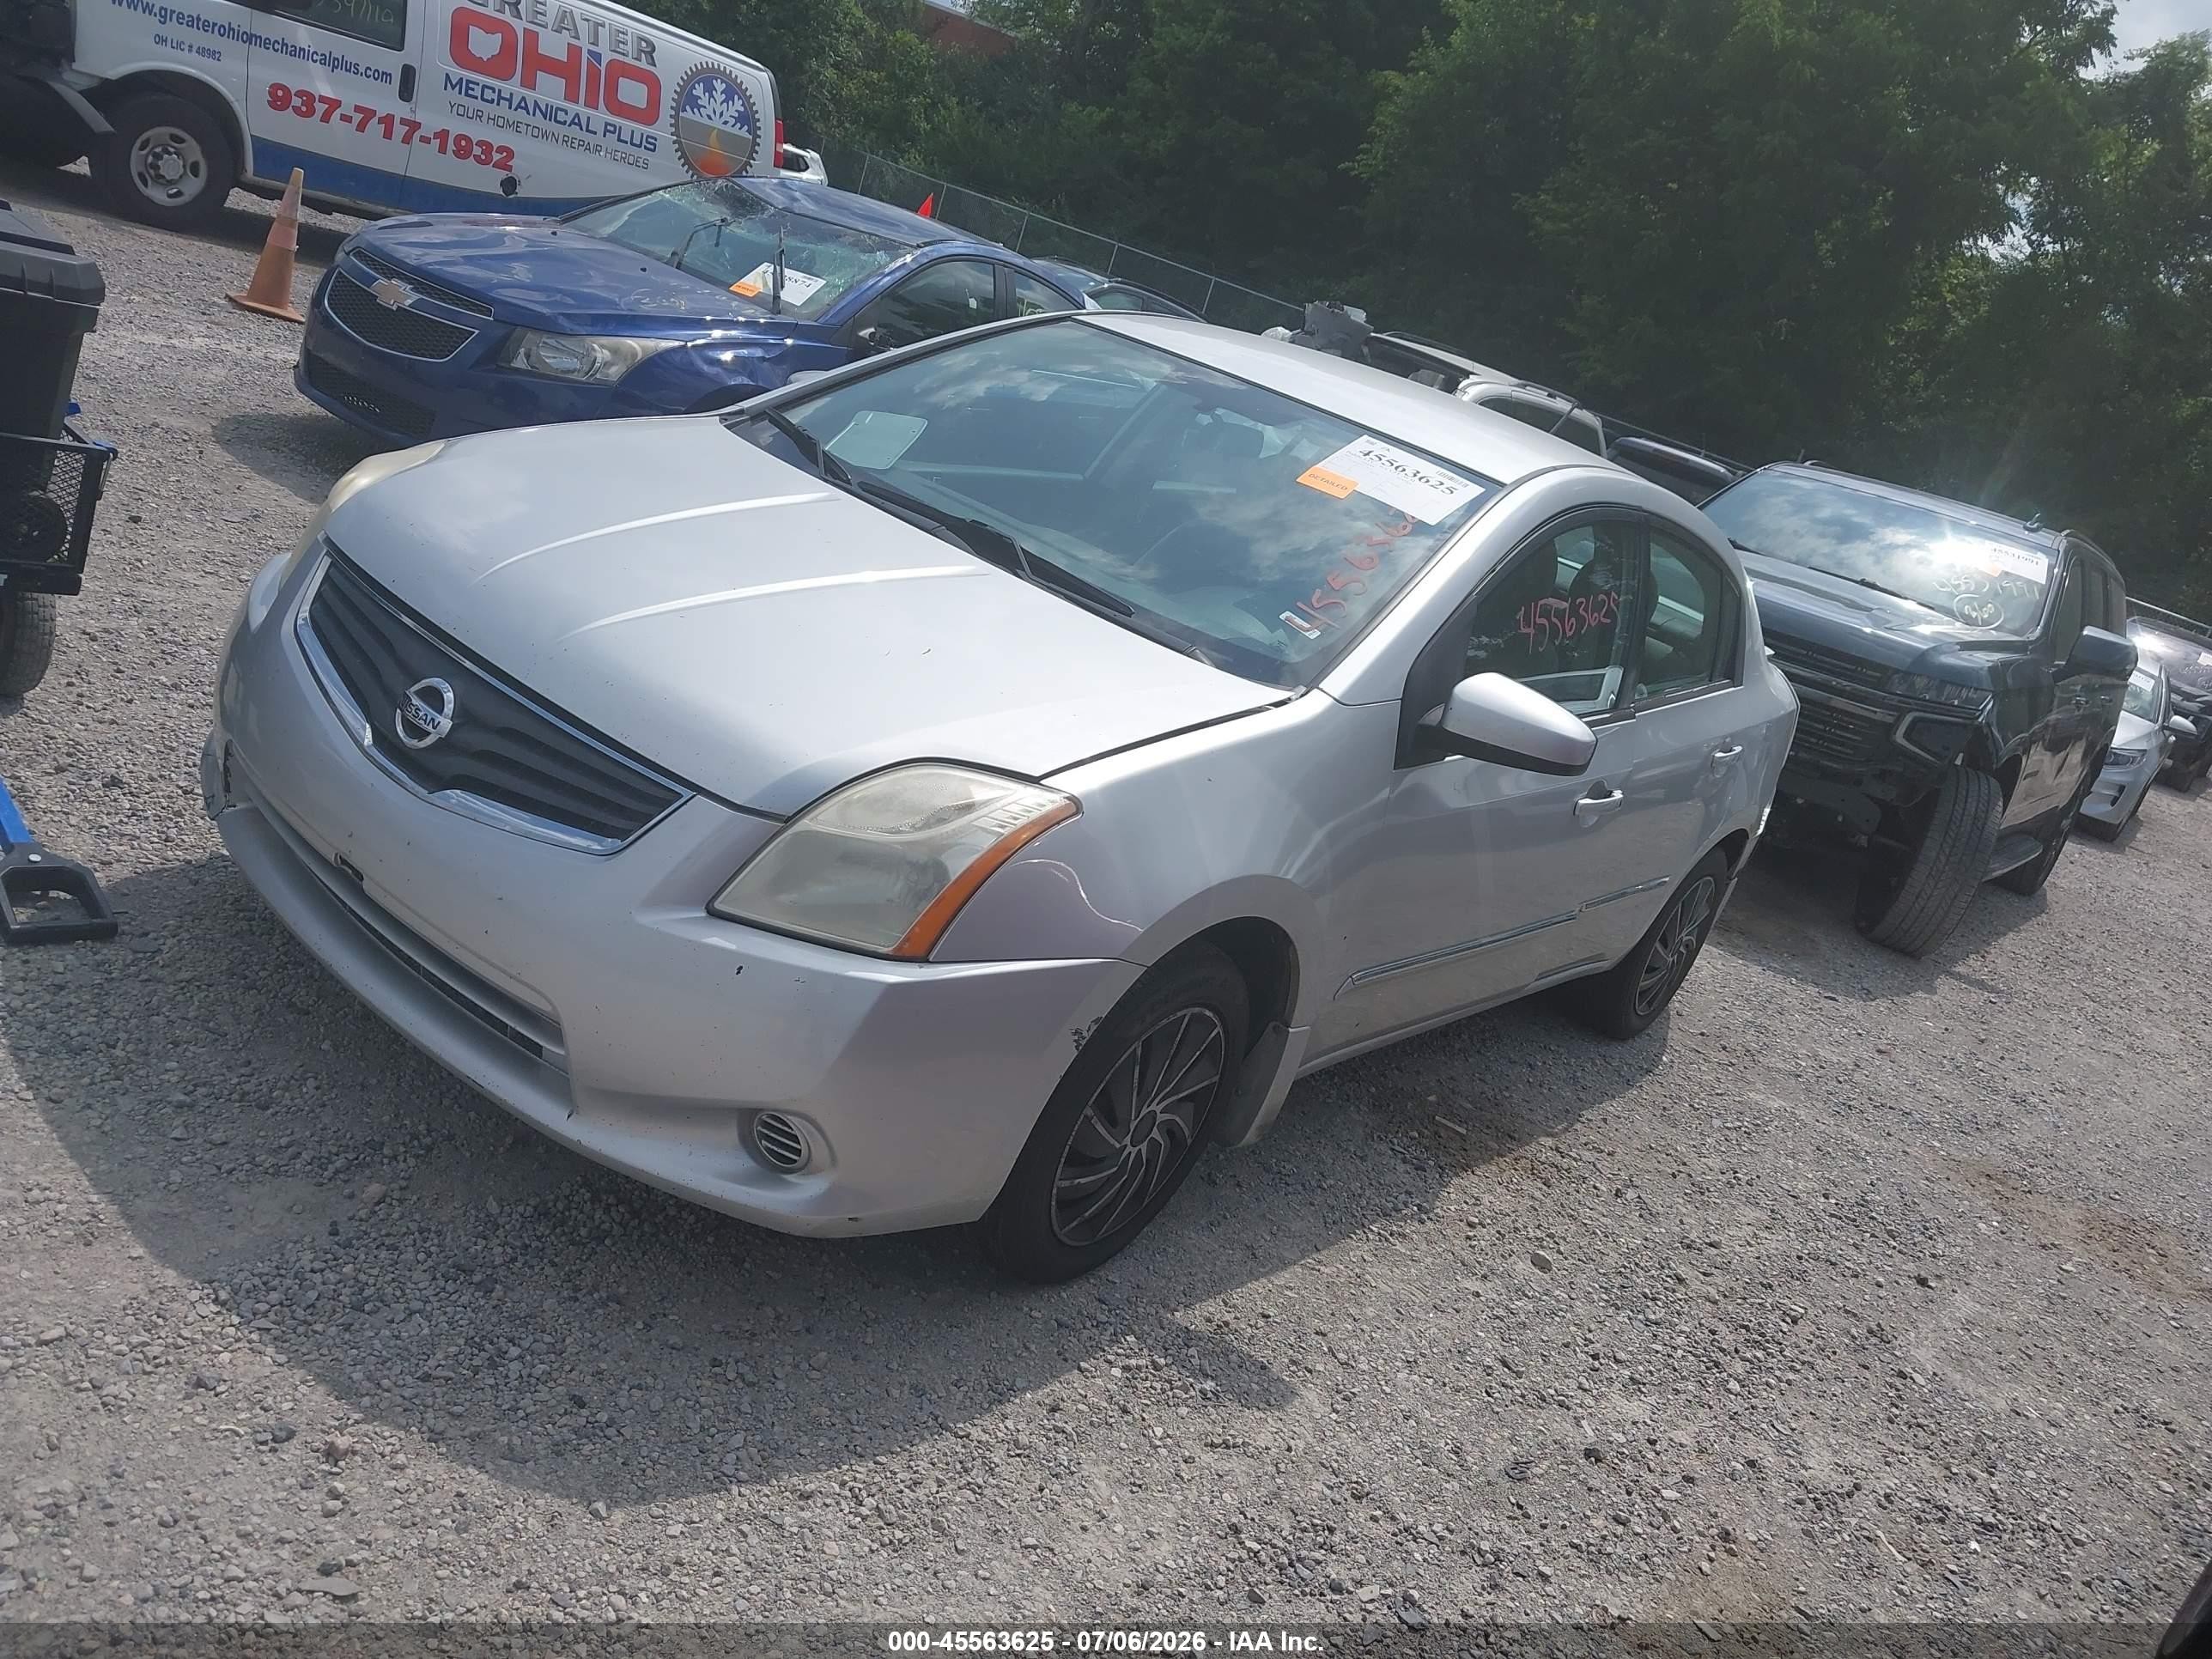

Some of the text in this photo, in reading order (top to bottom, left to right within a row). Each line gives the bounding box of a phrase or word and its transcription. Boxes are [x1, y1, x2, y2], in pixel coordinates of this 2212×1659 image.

[154, 33, 222, 62] OH LIC # 48982
[468, 0, 658, 67] REATER
[267, 82, 515, 172] 937-717-1932
[443, 72, 659, 153] MECHANICAL PLUS
[448, 100, 650, 170] YOUR HOMETOWN REPAIR HEROES
[1308, 473, 1348, 491] DETAILED
[1358, 448, 1459, 495] 45563625
[1516, 590, 1621, 654] 45563625
[400, 697, 441, 731] SSAN
